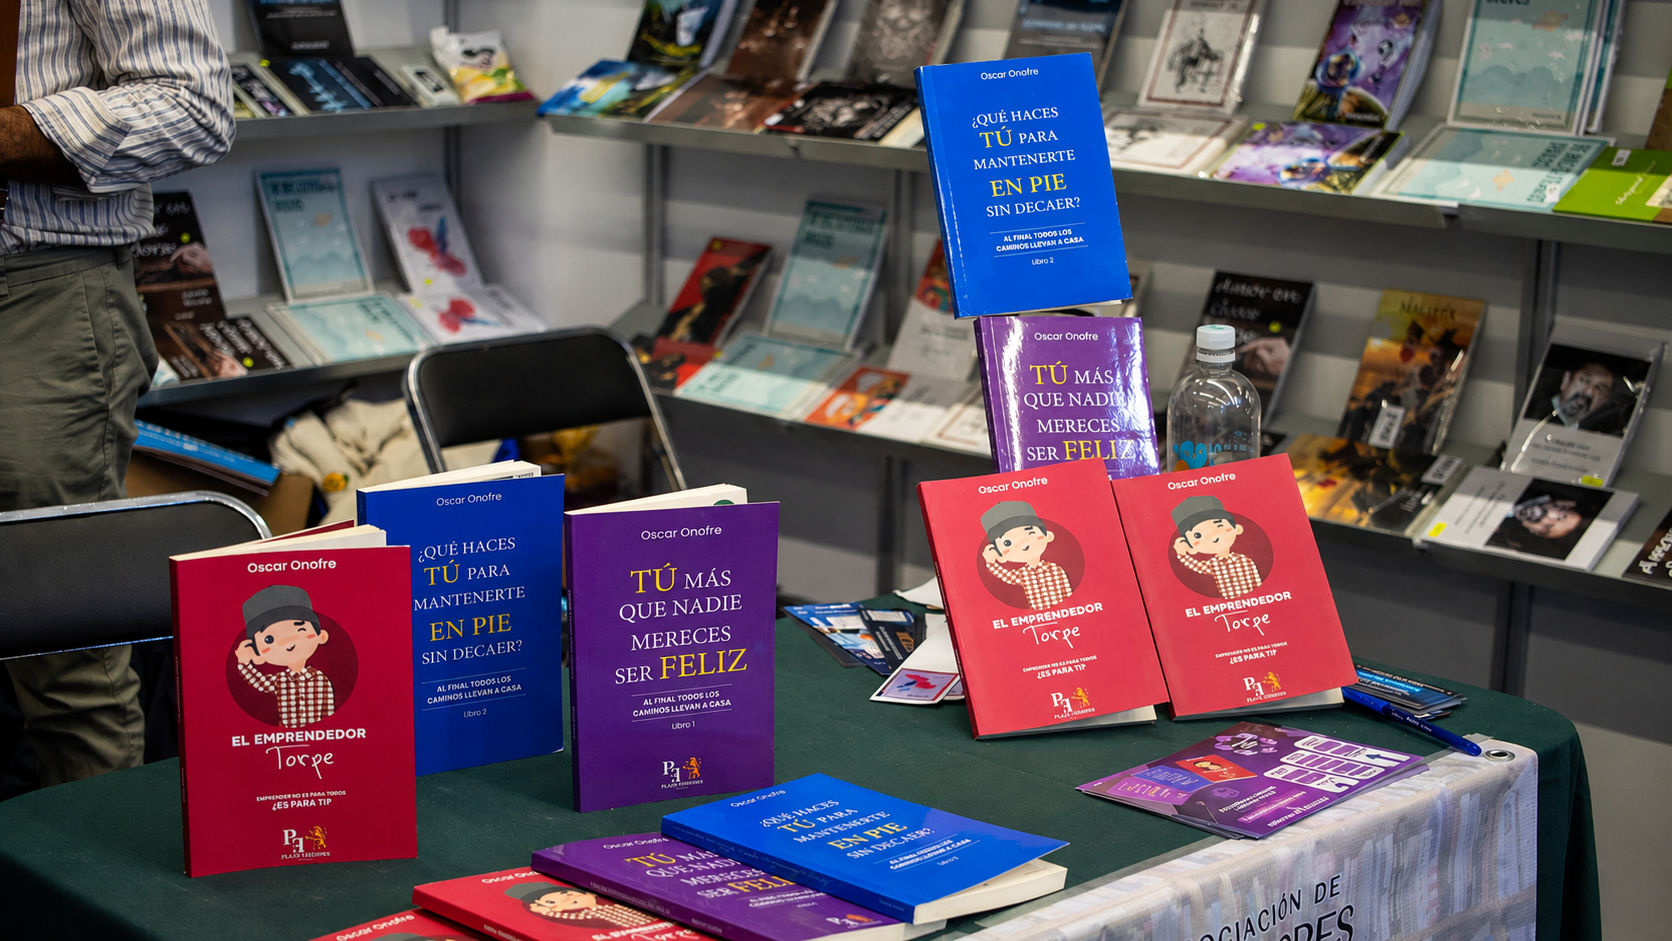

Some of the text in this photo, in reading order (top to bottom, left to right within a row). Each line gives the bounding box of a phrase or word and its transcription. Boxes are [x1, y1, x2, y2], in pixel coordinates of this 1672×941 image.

[980, 67, 1039, 80] Oscar Onofre
[972, 106, 1059, 129] ¿QUÉ HACES
[979, 127, 1058, 148] TÚ PARA
[973, 150, 1076, 170] MANTENERTE
[990, 173, 1068, 198] EN PIE
[986, 196, 1080, 218] SIN DECAER?
[996, 242, 1030, 252] CAMINOS
[1030, 240, 1057, 249] LLEVAN
[1064, 236, 1084, 244] CASA
[1013, 233, 1033, 242] FINAL
[1034, 230, 1058, 239] TODOS
[1058, 228, 1072, 236] LOS
[1032, 256, 1055, 266] Libro 2
[1034, 331, 1099, 342] Oscar Onofre
[1029, 360, 1114, 385] TÚ MÁS
[1024, 392, 1122, 410] QUE NADI
[1037, 419, 1121, 434] MERECES
[1026, 440, 1136, 461] SER FELIZ
[978, 476, 1048, 494] Oscar Onofre
[1168, 472, 1236, 490] Oscar Onofre
[436, 492, 502, 507] Oscar Onofre
[640, 524, 722, 541] Oscar Onofre
[418, 537, 516, 563] ¿QUÉ HACES
[247, 558, 337, 574] Oscar Onofre
[424, 560, 511, 586] TÚ PARA
[630, 562, 732, 594] TÚ MÁS
[414, 586, 526, 612] MANTENERTE
[618, 594, 743, 624] QUE NADIE
[1185, 591, 1292, 618] EL EMPRENDEDOR
[992, 602, 1104, 630] EL EMPRENDEDOR
[1214, 610, 1272, 636] Torpe
[430, 613, 512, 642] EN PIE
[1022, 621, 1081, 649] Torpe
[631, 625, 732, 651] MERECES
[422, 639, 523, 665] SIN DECAER?
[1244, 652, 1266, 662] PARA
[614, 648, 748, 685] SER FELIZ
[1052, 666, 1074, 676] PARA
[427, 692, 464, 704] CAMINOS
[464, 688, 494, 699] LLEVAN
[500, 684, 522, 693] CASA
[436, 675, 512, 693] AL FINAL TODOS LOS
[632, 706, 670, 717] CAMINOS
[671, 703, 701, 712] LLEVAN
[709, 699, 732, 708] CASA
[643, 690, 720, 706] AL FINAL TODOS LOS
[463, 710, 482, 718] Libro
[672, 720, 696, 730] Libro 1
[232, 728, 366, 747] EL EMPRENDEDOR
[266, 744, 334, 780] Torpe
[272, 802, 289, 811] ¿ES
[290, 800, 316, 808] PARA
[777, 808, 858, 833] TÚ PARA
[793, 811, 890, 844] MANTENERTE
[827, 834, 869, 850] EN
[863, 822, 908, 840] PIE
[624, 852, 676, 868] TÚ
[846, 847, 875, 858] SIN
[646, 858, 742, 878] QUE NADI
[697, 886, 739, 899] SER
[728, 876, 796, 892] FELI
[1314, 874, 1341, 905] DE
